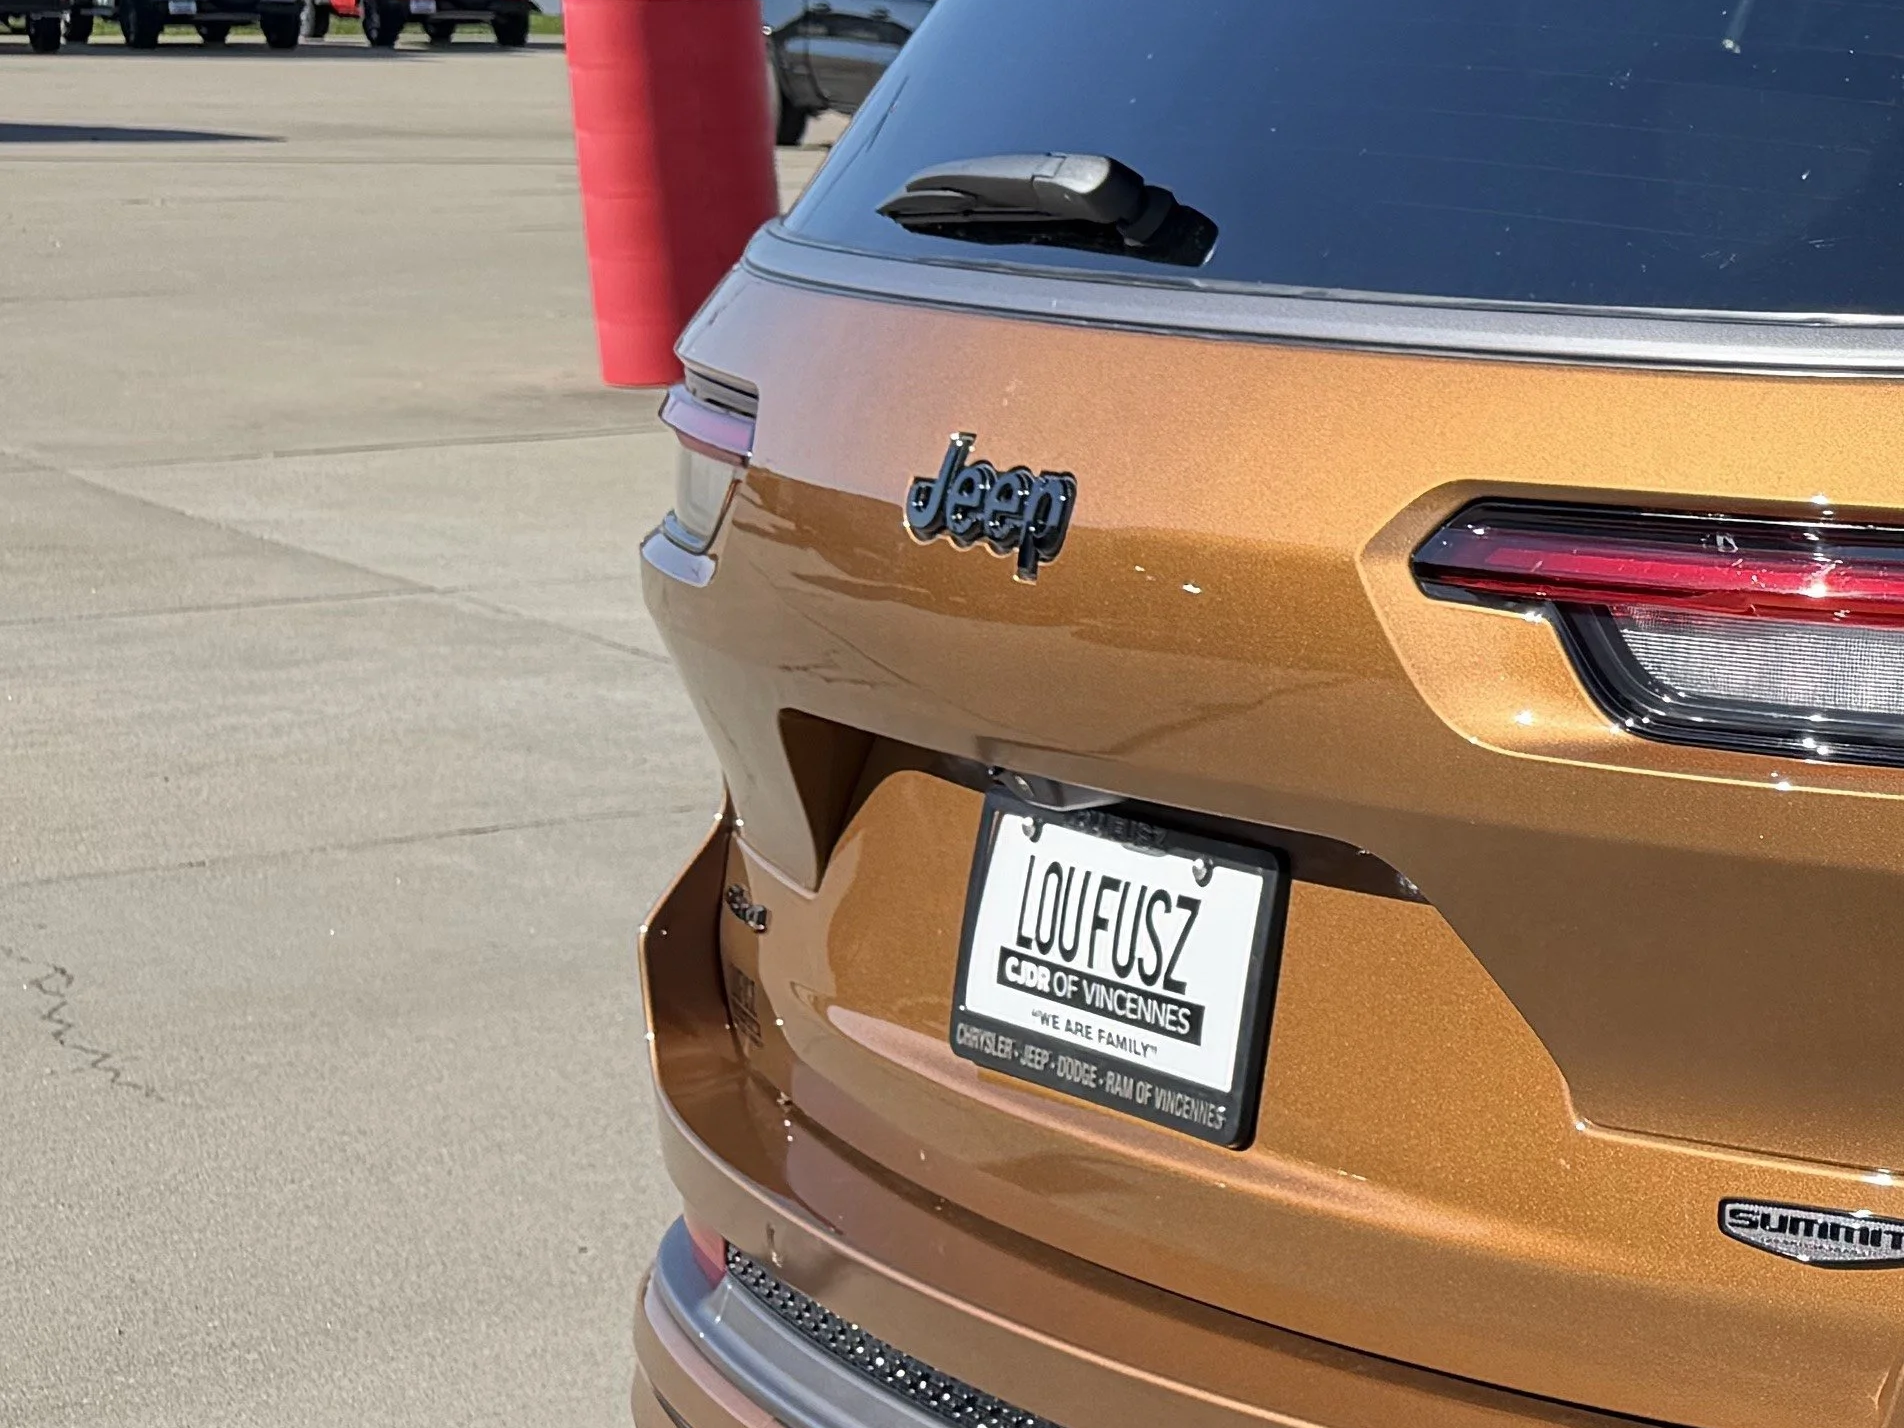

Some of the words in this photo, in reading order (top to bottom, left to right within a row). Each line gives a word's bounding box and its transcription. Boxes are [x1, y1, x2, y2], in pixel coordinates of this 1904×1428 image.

[903, 431, 1077, 584] Jeep
[1015, 853, 1090, 964] LOU
[1087, 873, 1202, 996] FUSZ
[1005, 956, 1051, 993] CJDR
[1052, 971, 1079, 1000] OF
[1082, 978, 1192, 1036] VINCENNES
[1064, 1018, 1093, 1039] ARE
[956, 1022, 1014, 1060] CHRYSLER
[1019, 1044, 1050, 1071] JEEP
[1056, 1056, 1098, 1089] DODGE
[1105, 1070, 1134, 1100] RAM
[1135, 1080, 1152, 1107] OF
[1154, 1087, 1228, 1131] VINCENNES
